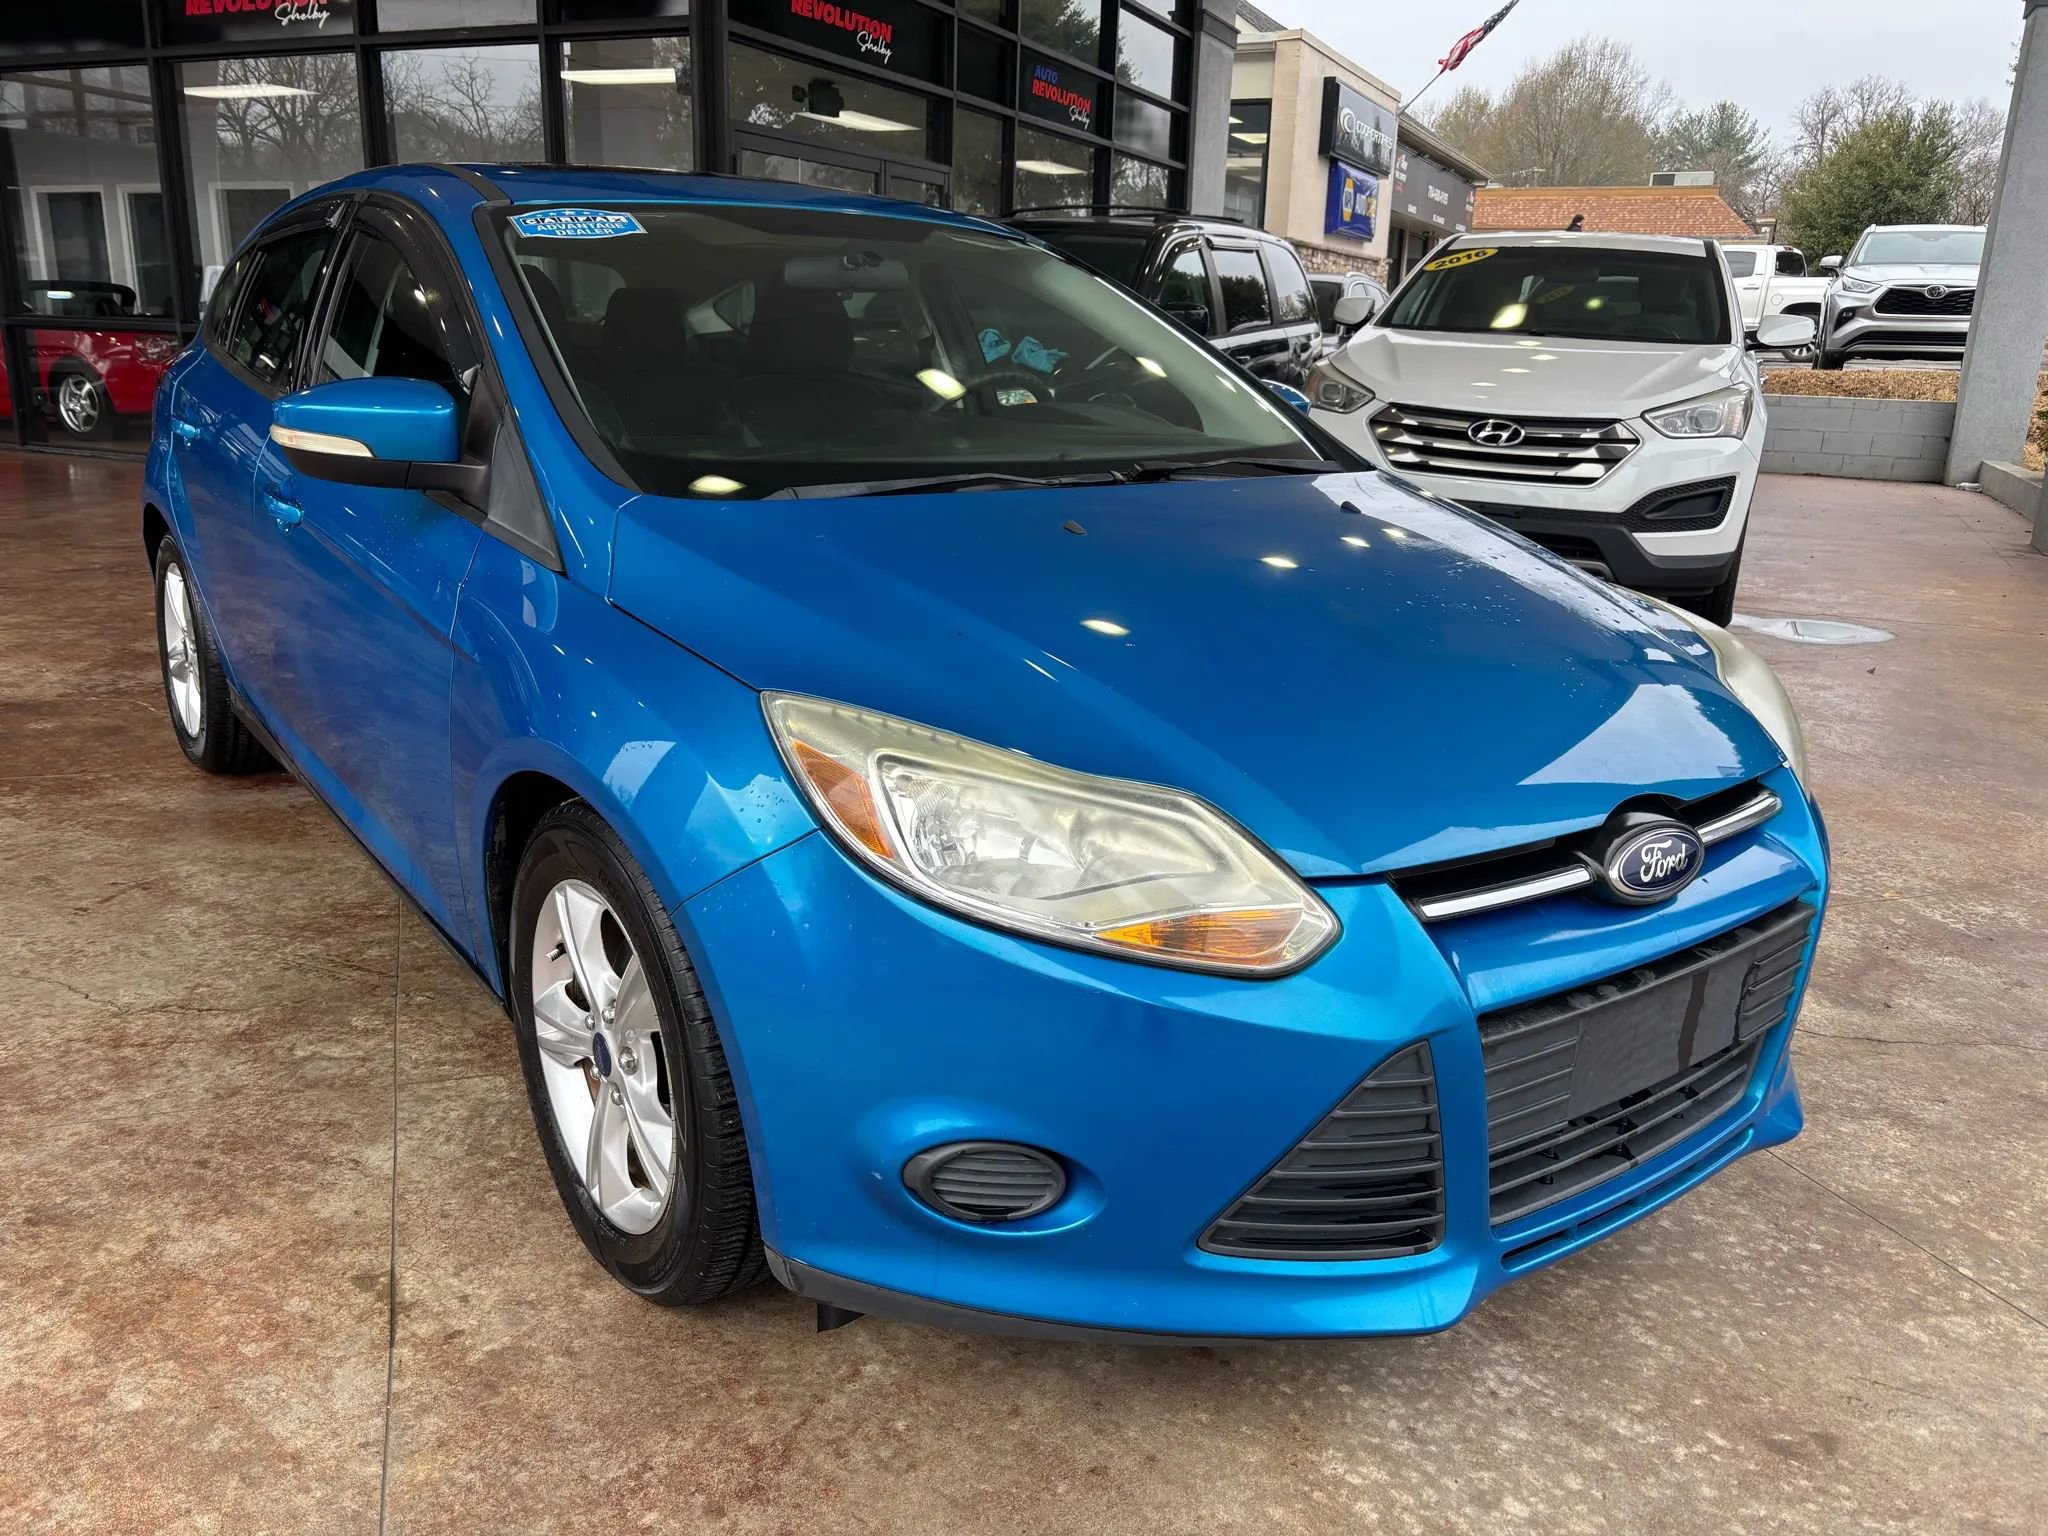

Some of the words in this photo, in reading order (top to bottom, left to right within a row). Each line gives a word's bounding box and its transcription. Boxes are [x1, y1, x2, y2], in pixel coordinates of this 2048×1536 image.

[274, 0, 331, 30] Shelby
[791, 0, 893, 44] REVOLUTION
[856, 30, 893, 65] Shelby
[1034, 64, 1058, 85] AUTO
[1032, 79, 1092, 114] REVOLUTION
[537, 222, 625, 231] ADVANTAGE
[1434, 249, 1489, 269] 2016
[1640, 839, 1689, 883] Ford
